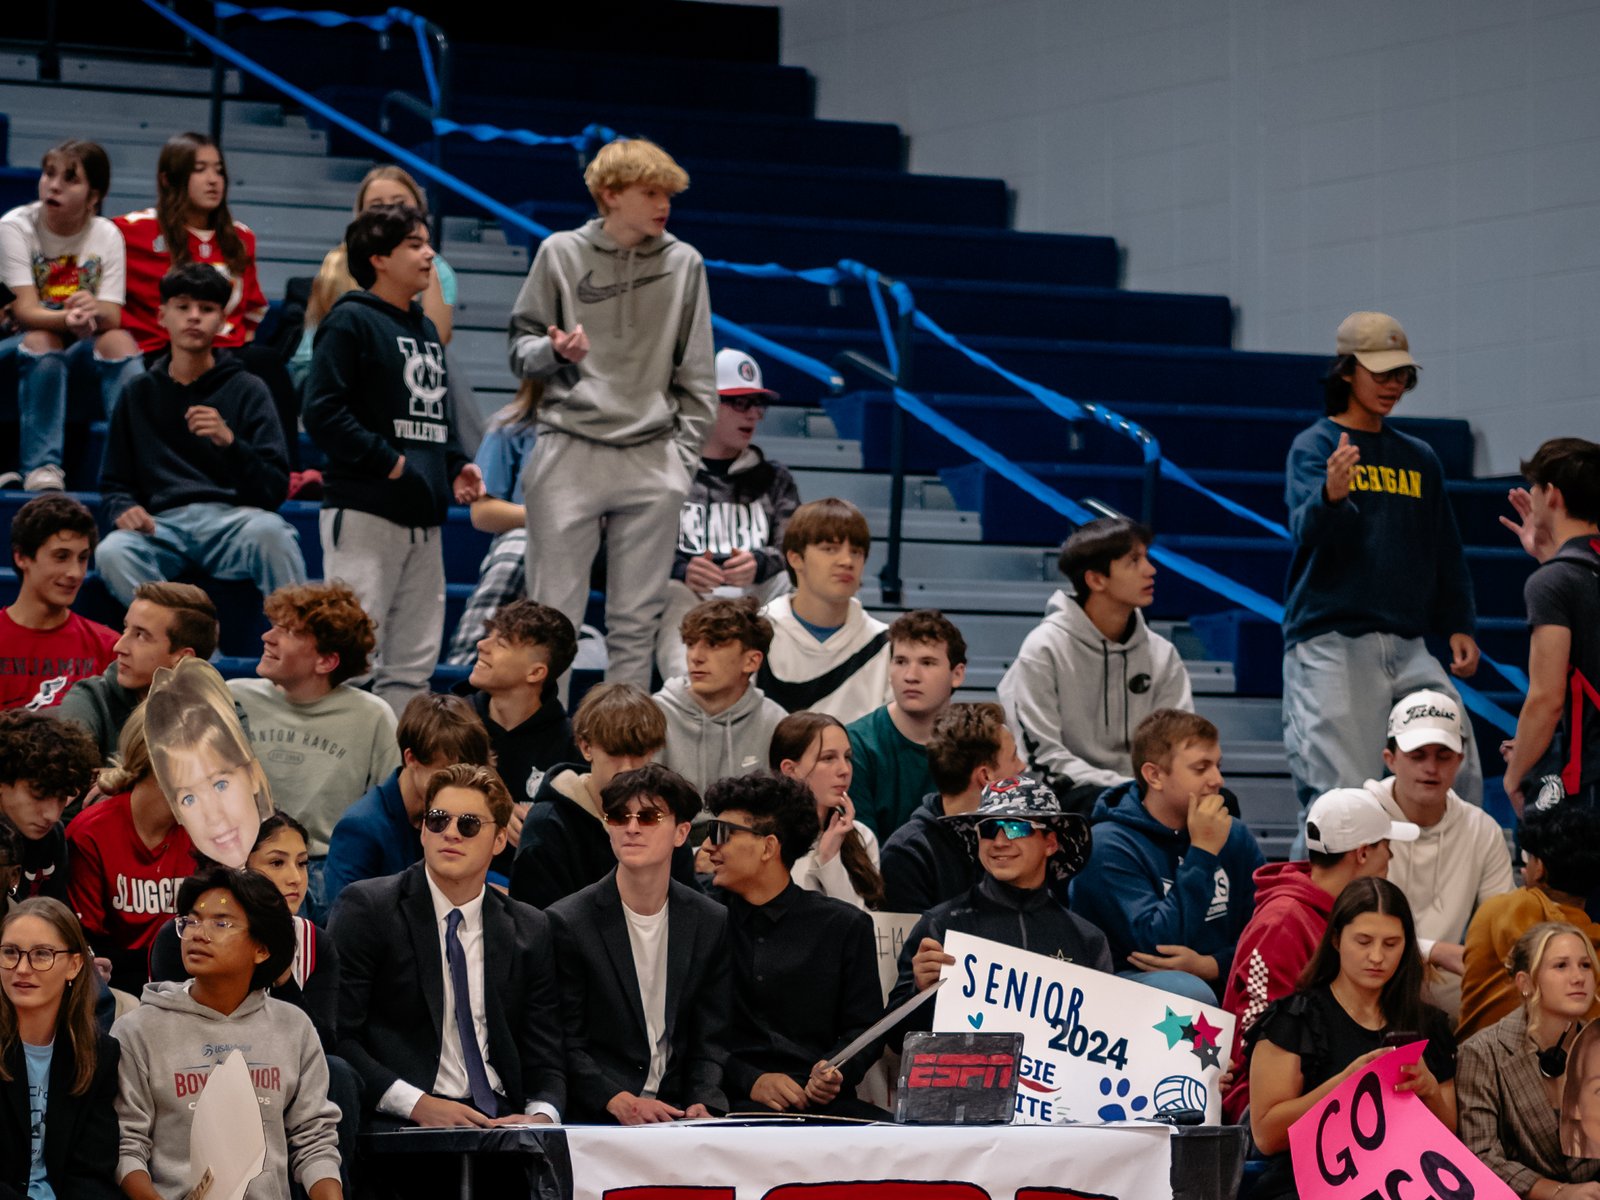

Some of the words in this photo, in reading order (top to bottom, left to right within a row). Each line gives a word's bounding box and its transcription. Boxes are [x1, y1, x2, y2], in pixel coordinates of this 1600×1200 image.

[1348, 464, 1422, 499] ICHIGAN
[708, 501, 769, 554] NBA
[0, 656, 95, 676] ENJAMIN
[249, 728, 296, 744] ANTOM
[302, 732, 347, 760] RANCH
[112, 872, 185, 915] SLUGG
[962, 953, 1084, 1027] SENIOR
[1047, 1017, 1129, 1072] 2024
[174, 1072, 209, 1099] BOY
[907, 1053, 1014, 1089] ESPN
[1019, 1055, 1057, 1086] GIE
[1014, 1092, 1053, 1123] ITE
[1315, 1070, 1387, 1187] GO
